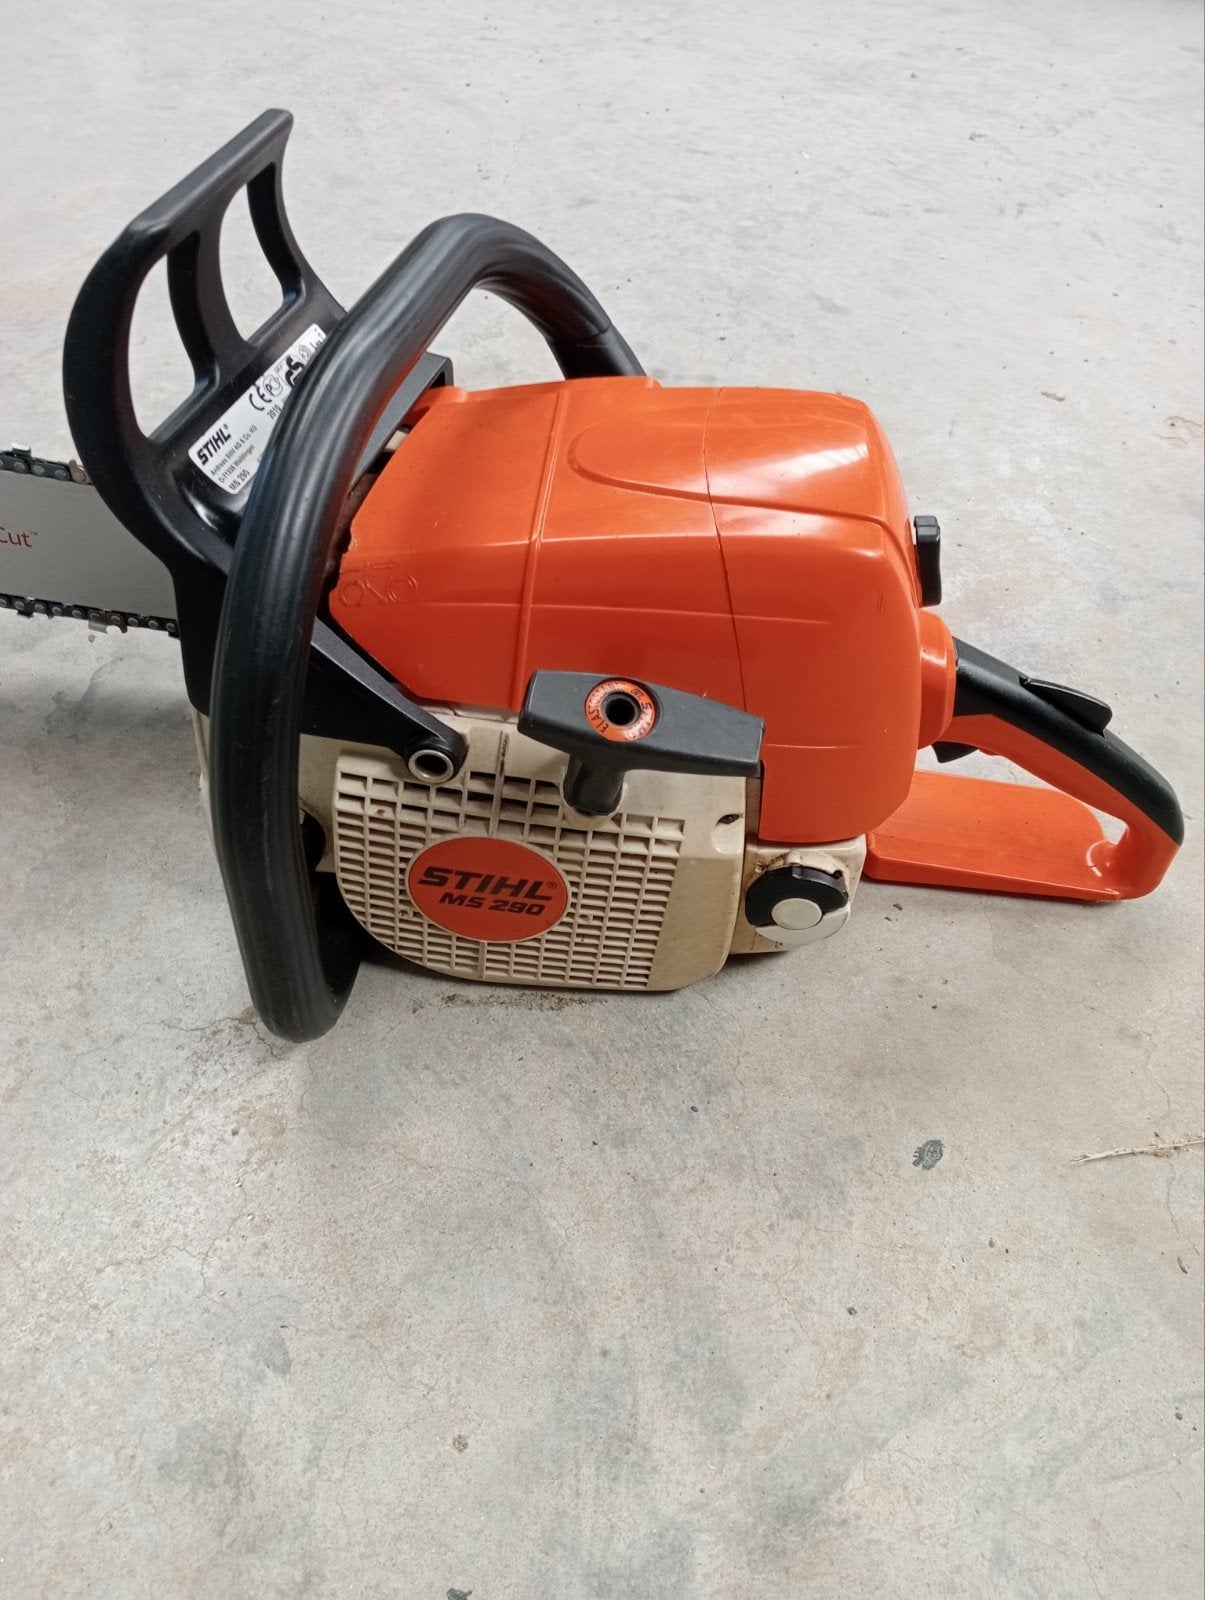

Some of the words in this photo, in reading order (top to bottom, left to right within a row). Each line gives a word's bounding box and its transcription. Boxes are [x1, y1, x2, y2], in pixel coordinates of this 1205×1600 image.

[197, 428, 231, 466] STIHL
[417, 866, 553, 901] STIHL
[439, 892, 487, 909] MS
[488, 899, 546, 916] 290
